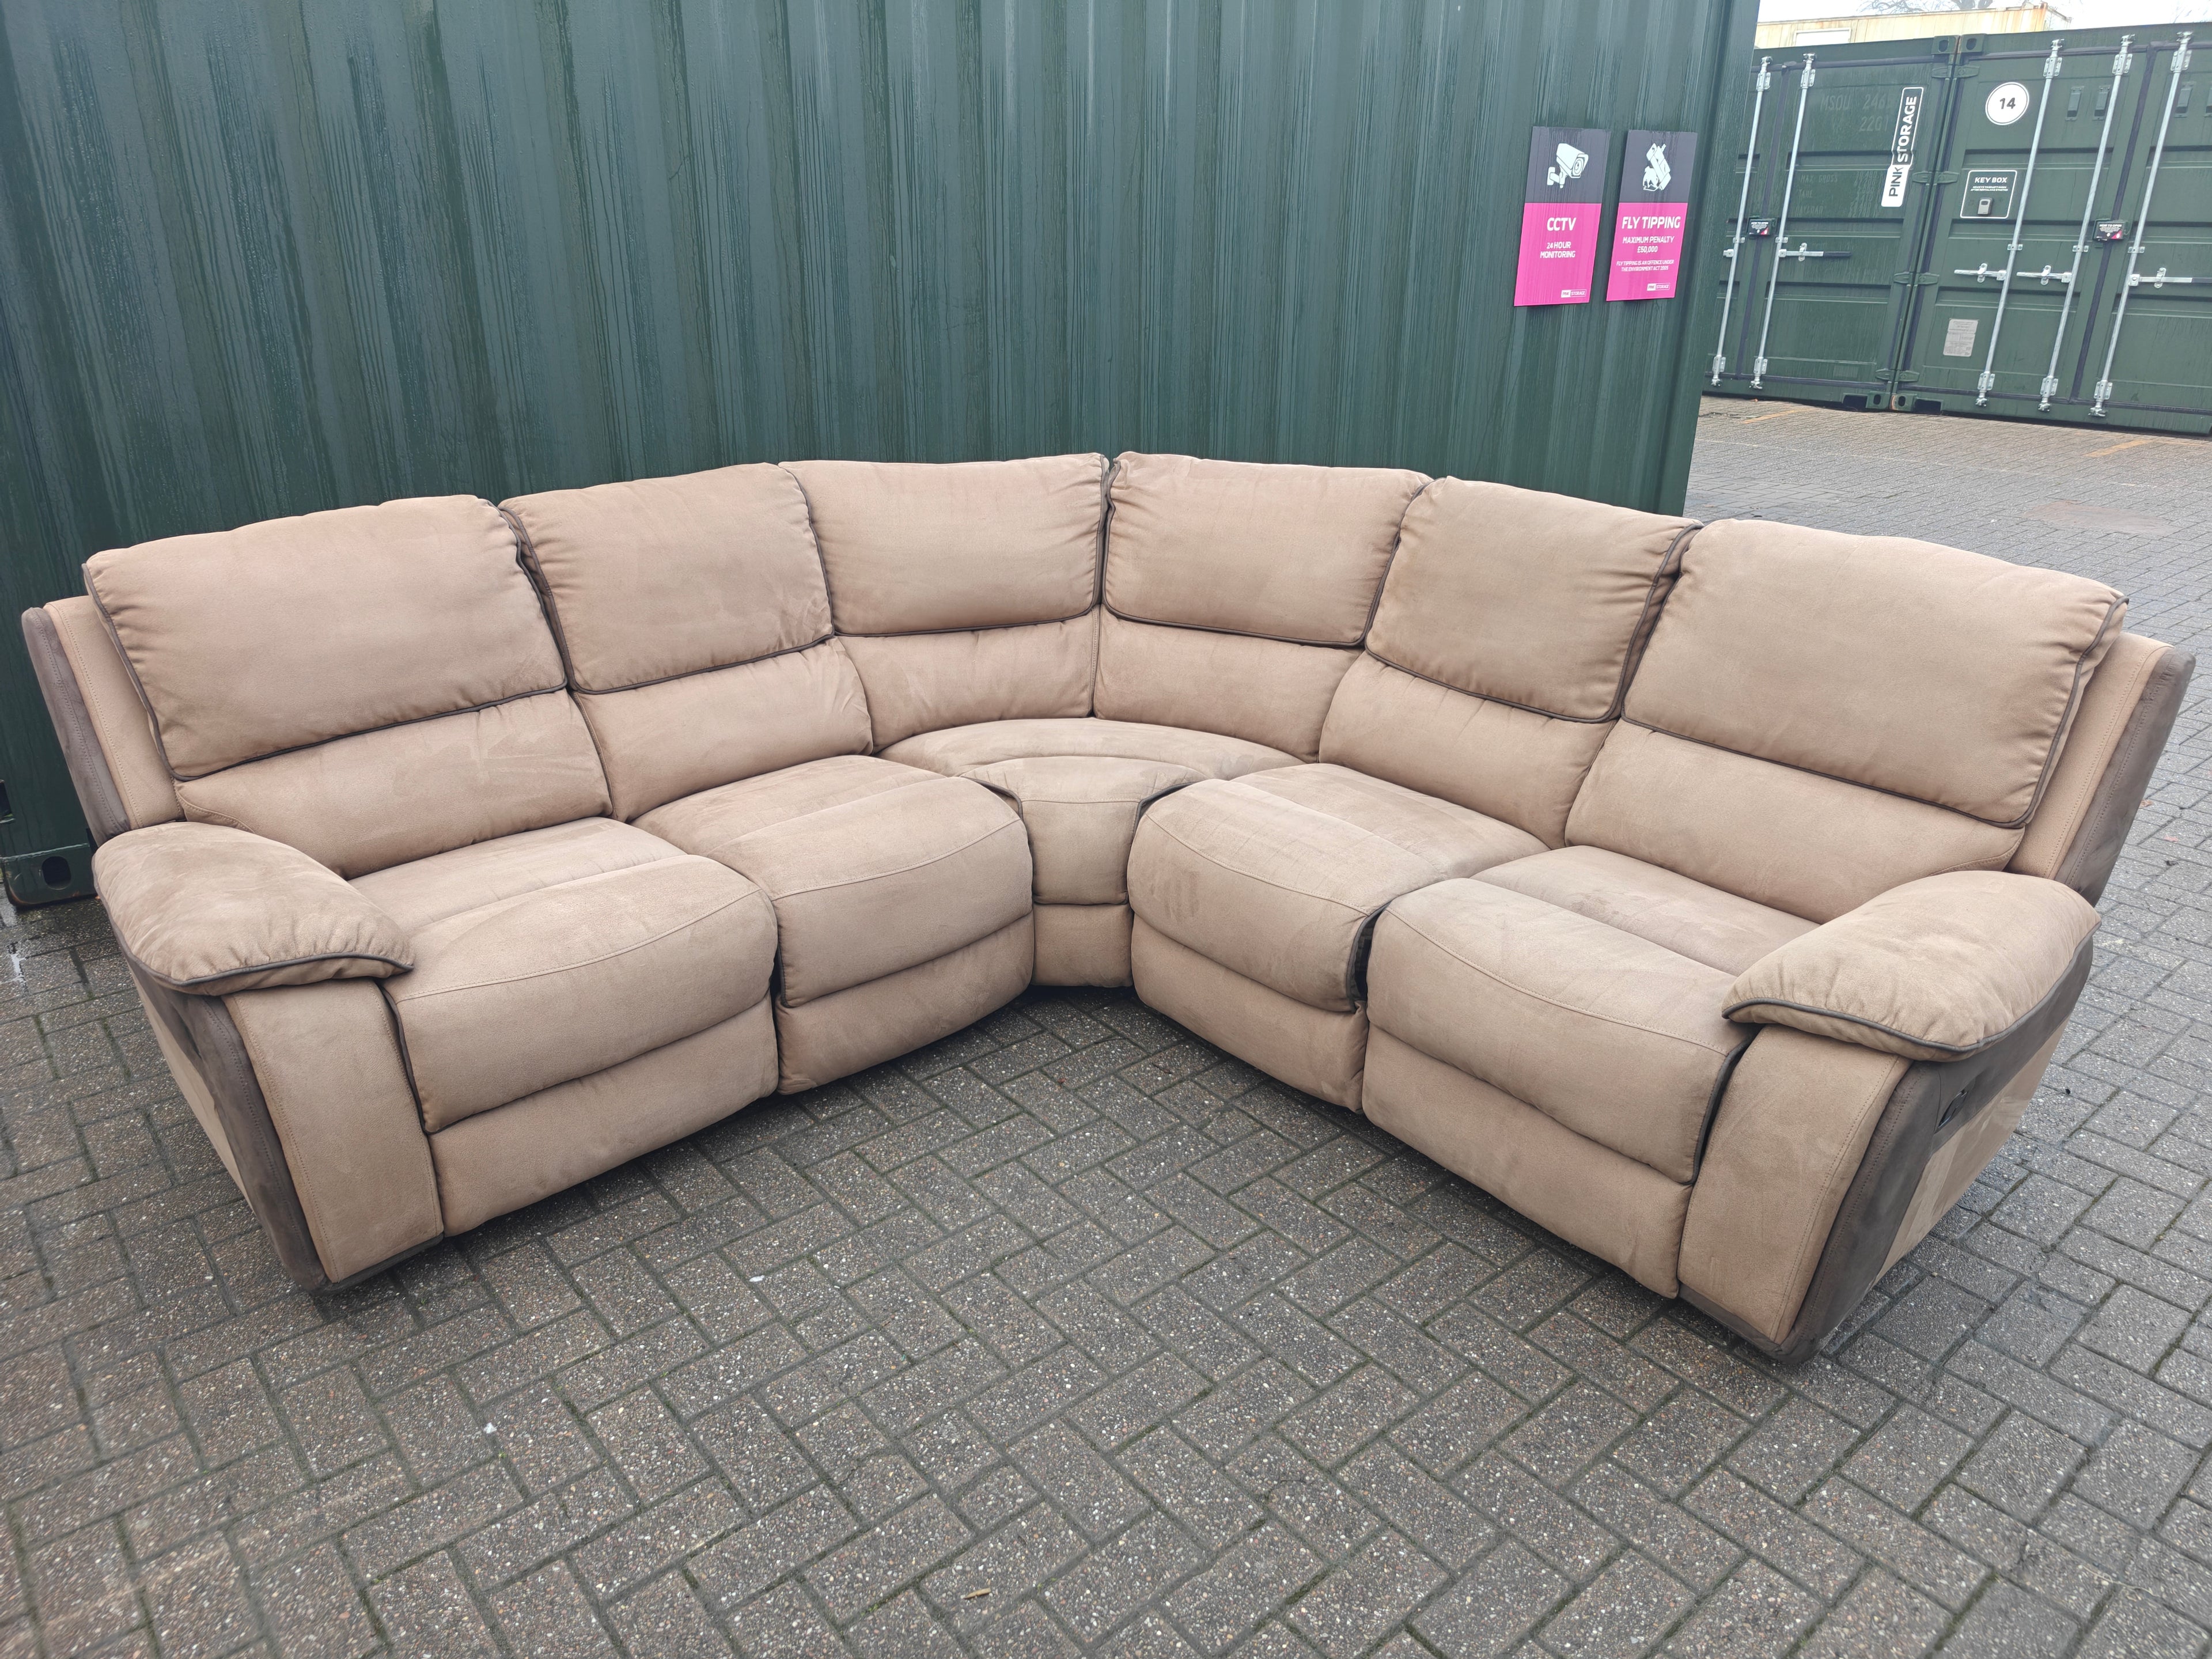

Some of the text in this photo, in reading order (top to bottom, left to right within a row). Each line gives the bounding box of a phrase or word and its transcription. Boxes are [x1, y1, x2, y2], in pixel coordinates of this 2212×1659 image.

[1999, 97, 2016, 109] 14
[1888, 96, 1917, 197] PINK STORAGE
[1547, 217, 1577, 231] CCTV
[1622, 216, 1681, 229] FLY TIPPING
[1540, 251, 1576, 259] MONITORING
[1637, 245, 1658, 253] £50,000
